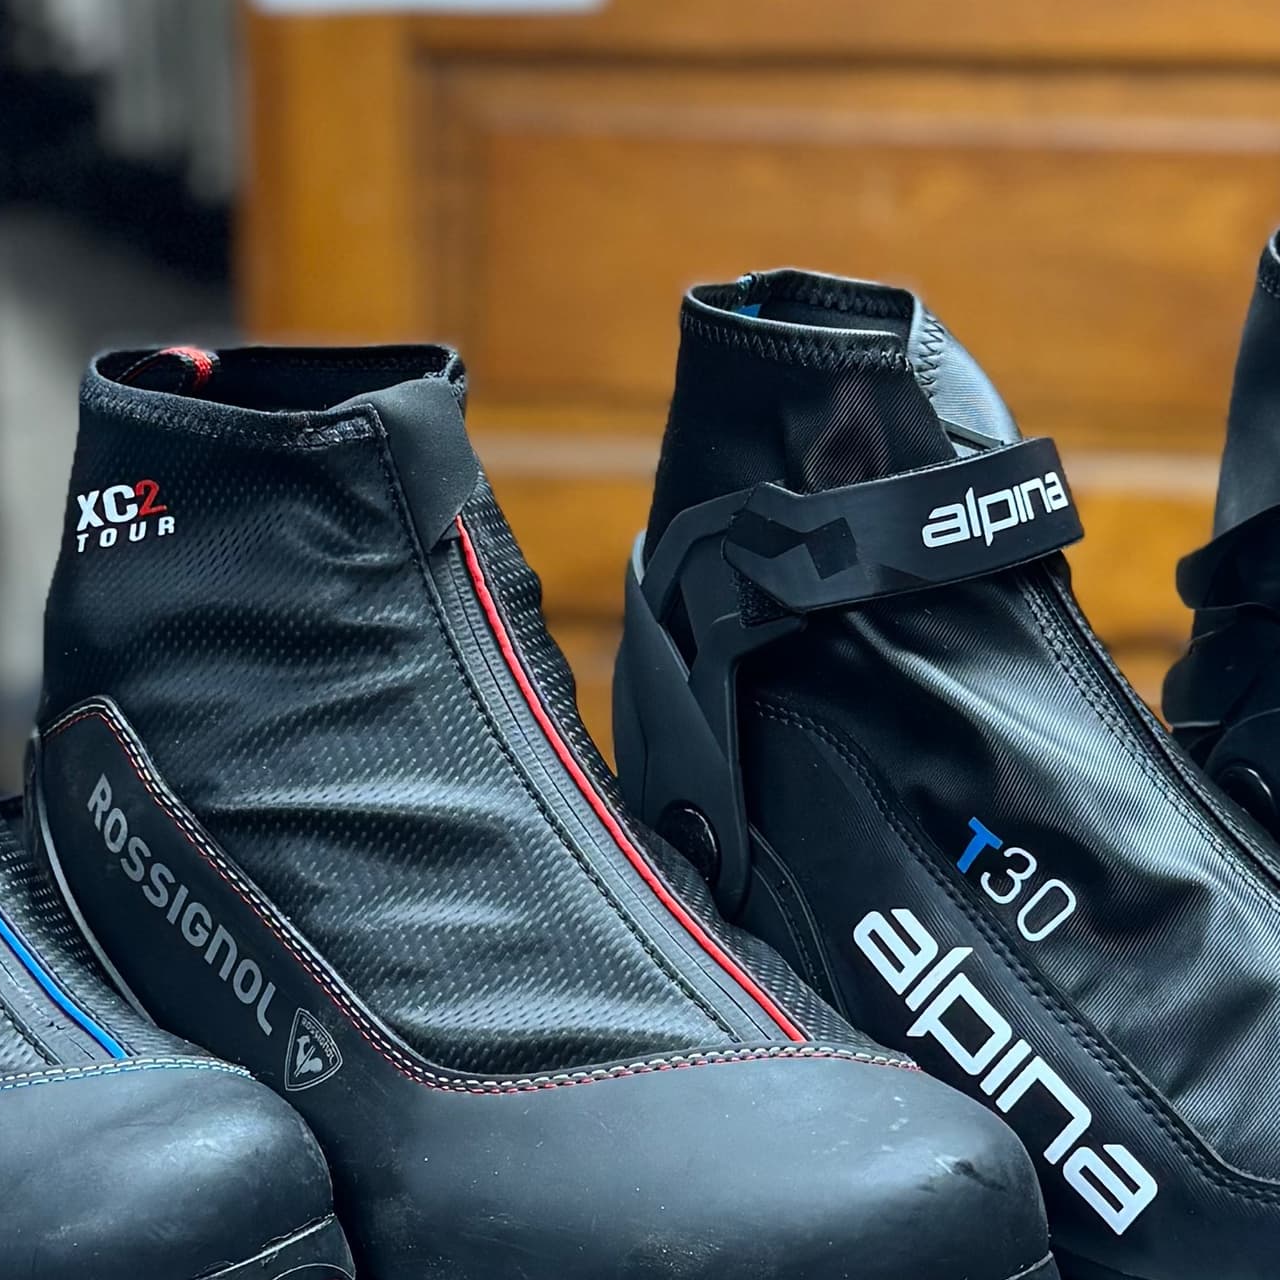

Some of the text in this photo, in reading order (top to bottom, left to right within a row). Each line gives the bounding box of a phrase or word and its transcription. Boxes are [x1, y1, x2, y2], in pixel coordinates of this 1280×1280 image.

[76, 479, 168, 532] XC2
[76, 515, 175, 553] TOUR
[922, 471, 1069, 548] alpina
[87, 773, 276, 1036] ROSSIGNOL
[956, 816, 1077, 942] T30
[853, 908, 1158, 1236] alpina
